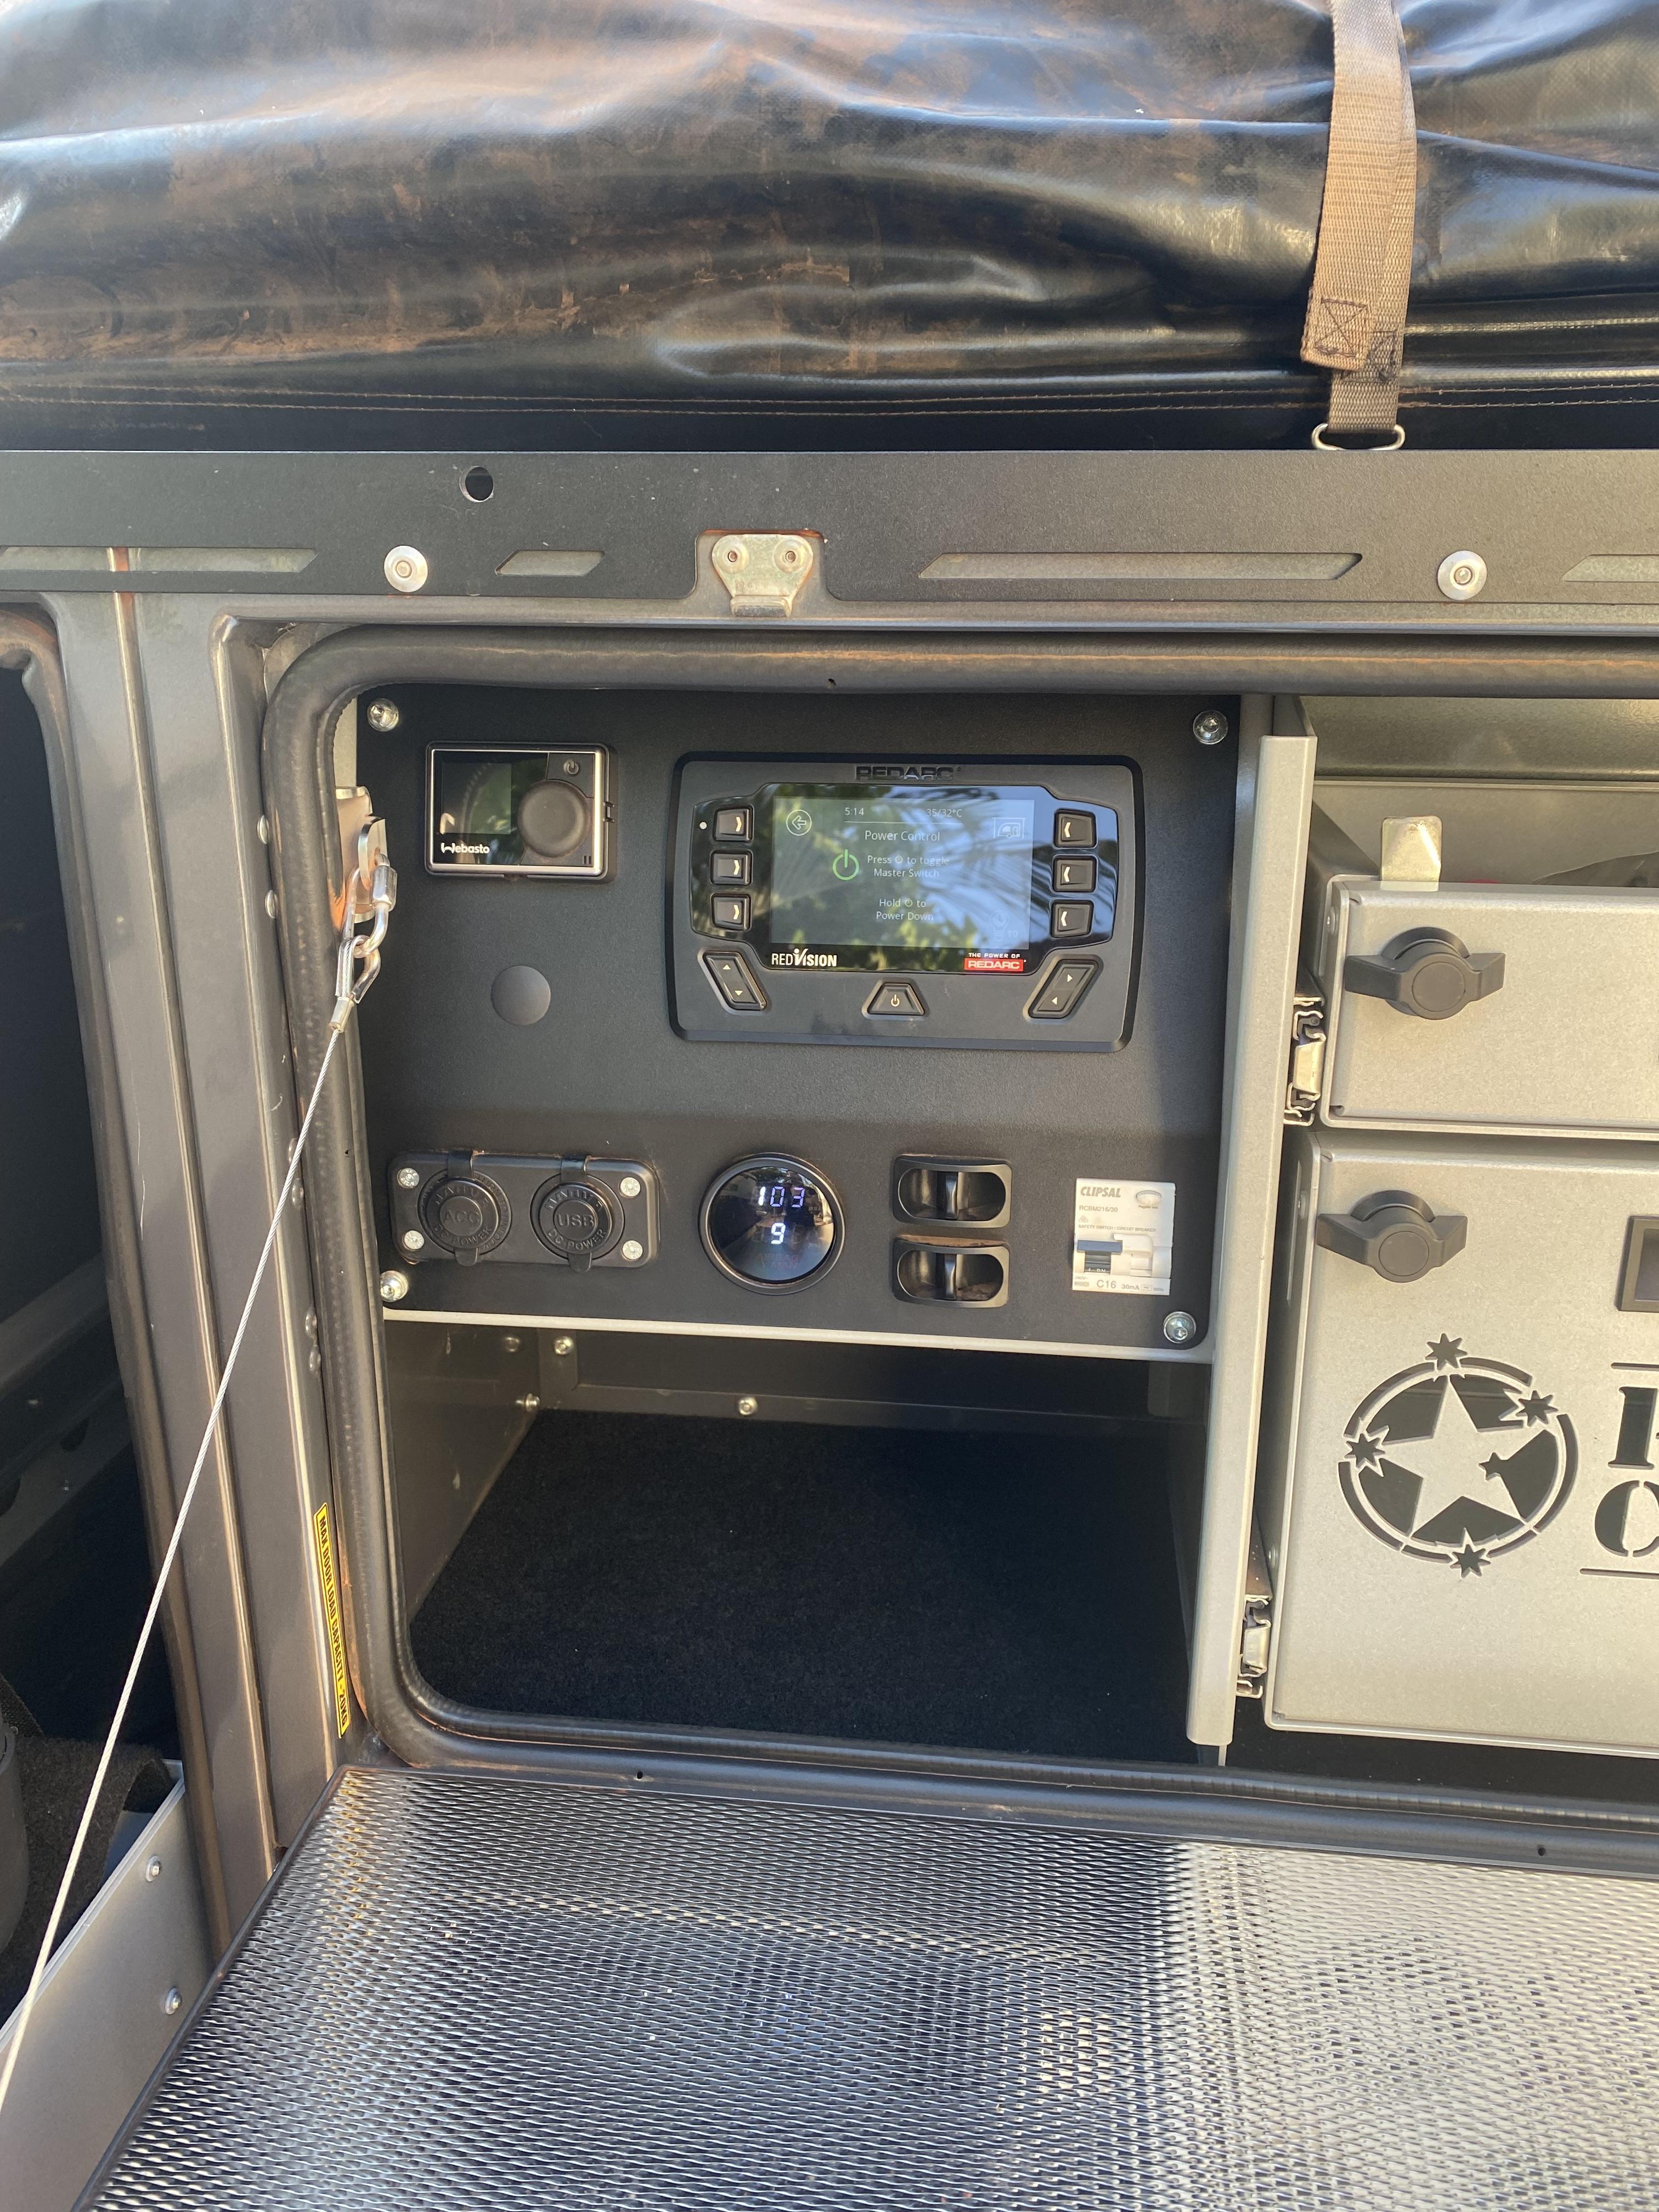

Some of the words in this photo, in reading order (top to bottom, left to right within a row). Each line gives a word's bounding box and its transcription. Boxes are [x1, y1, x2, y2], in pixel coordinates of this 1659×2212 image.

[855, 766, 955, 781] REDARC
[844, 807, 865, 816] 5:14
[865, 830, 898, 840] Power
[900, 831, 940, 842] Control
[441, 842, 490, 854] Webasto
[867, 855, 891, 864] Press
[907, 856, 917, 865] to
[919, 856, 950, 867] toggle
[873, 868, 906, 877] Master
[909, 868, 939, 878] Switch
[879, 898, 901, 907] Hold
[917, 899, 927, 907] to
[876, 911, 905, 920] Power
[907, 912, 934, 921] Down
[968, 959, 1021, 969] REDARC
[758, 1186, 805, 1208] 103
[1080, 1186, 1121, 1198] CLIPSAL
[444, 1209, 481, 1224] ACC
[557, 1214, 595, 1227] USB
[452, 1226, 492, 1245] POWER
[567, 1228, 606, 1251] POWER
[770, 1222, 786, 1245] 9
[1097, 1279, 1117, 1289] C16
[323, 1545, 332, 1585] DOOR
[328, 1583, 336, 1620] LOAD
[331, 1617, 344, 1682] CAPACITY
[339, 1688, 348, 1726] 20KG
